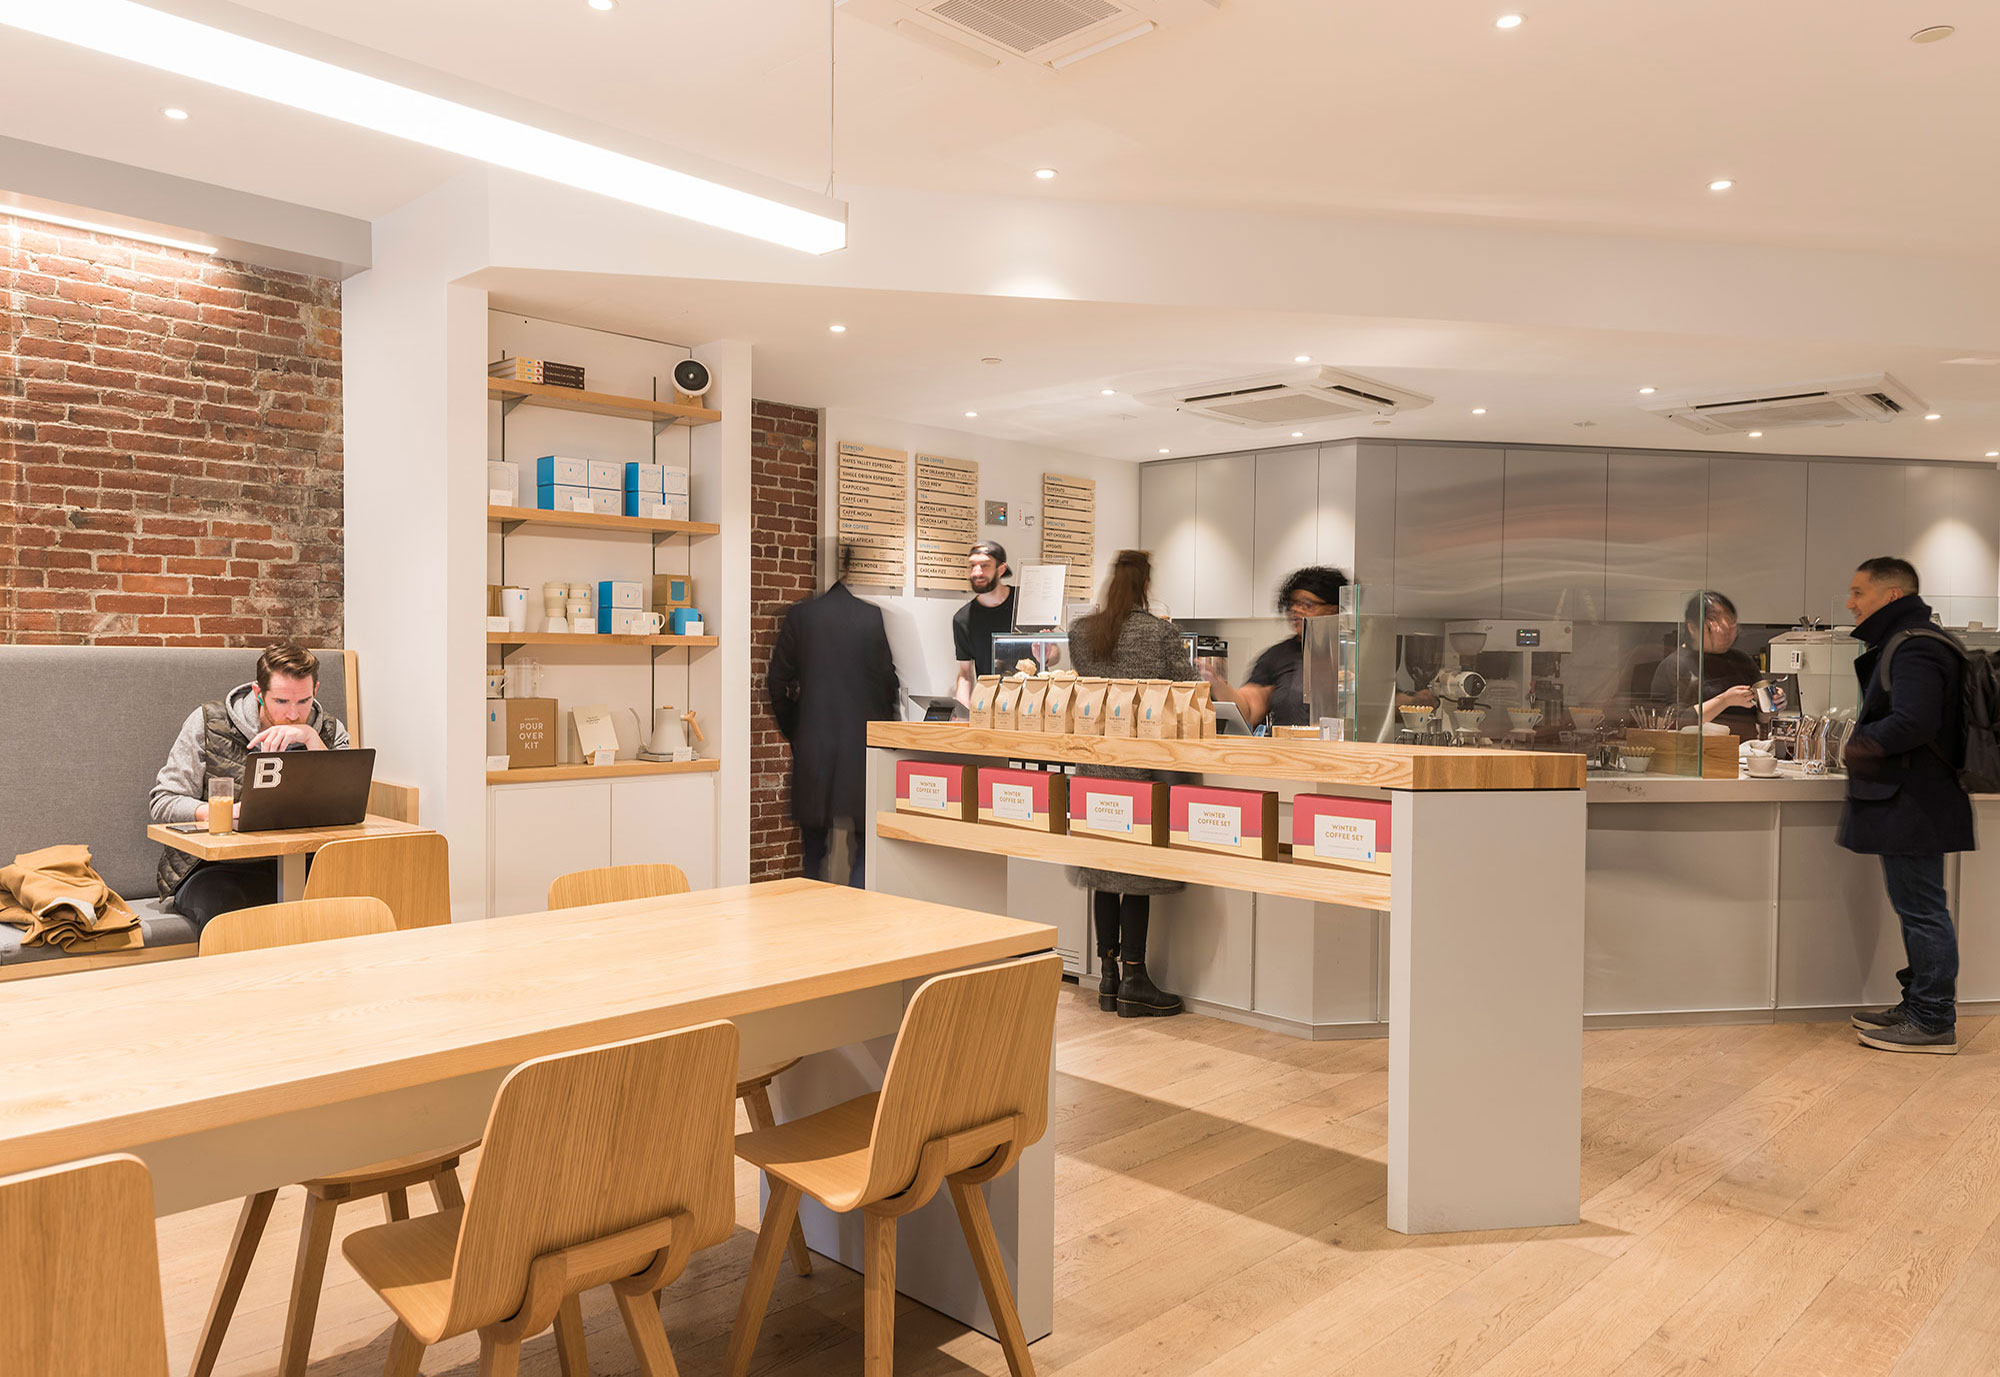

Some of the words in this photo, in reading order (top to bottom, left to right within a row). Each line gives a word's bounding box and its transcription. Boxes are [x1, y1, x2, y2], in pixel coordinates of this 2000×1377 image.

[519, 732, 543, 740] OVER
[253, 757, 284, 789] B
[1325, 832, 1350, 840] COFFEE
